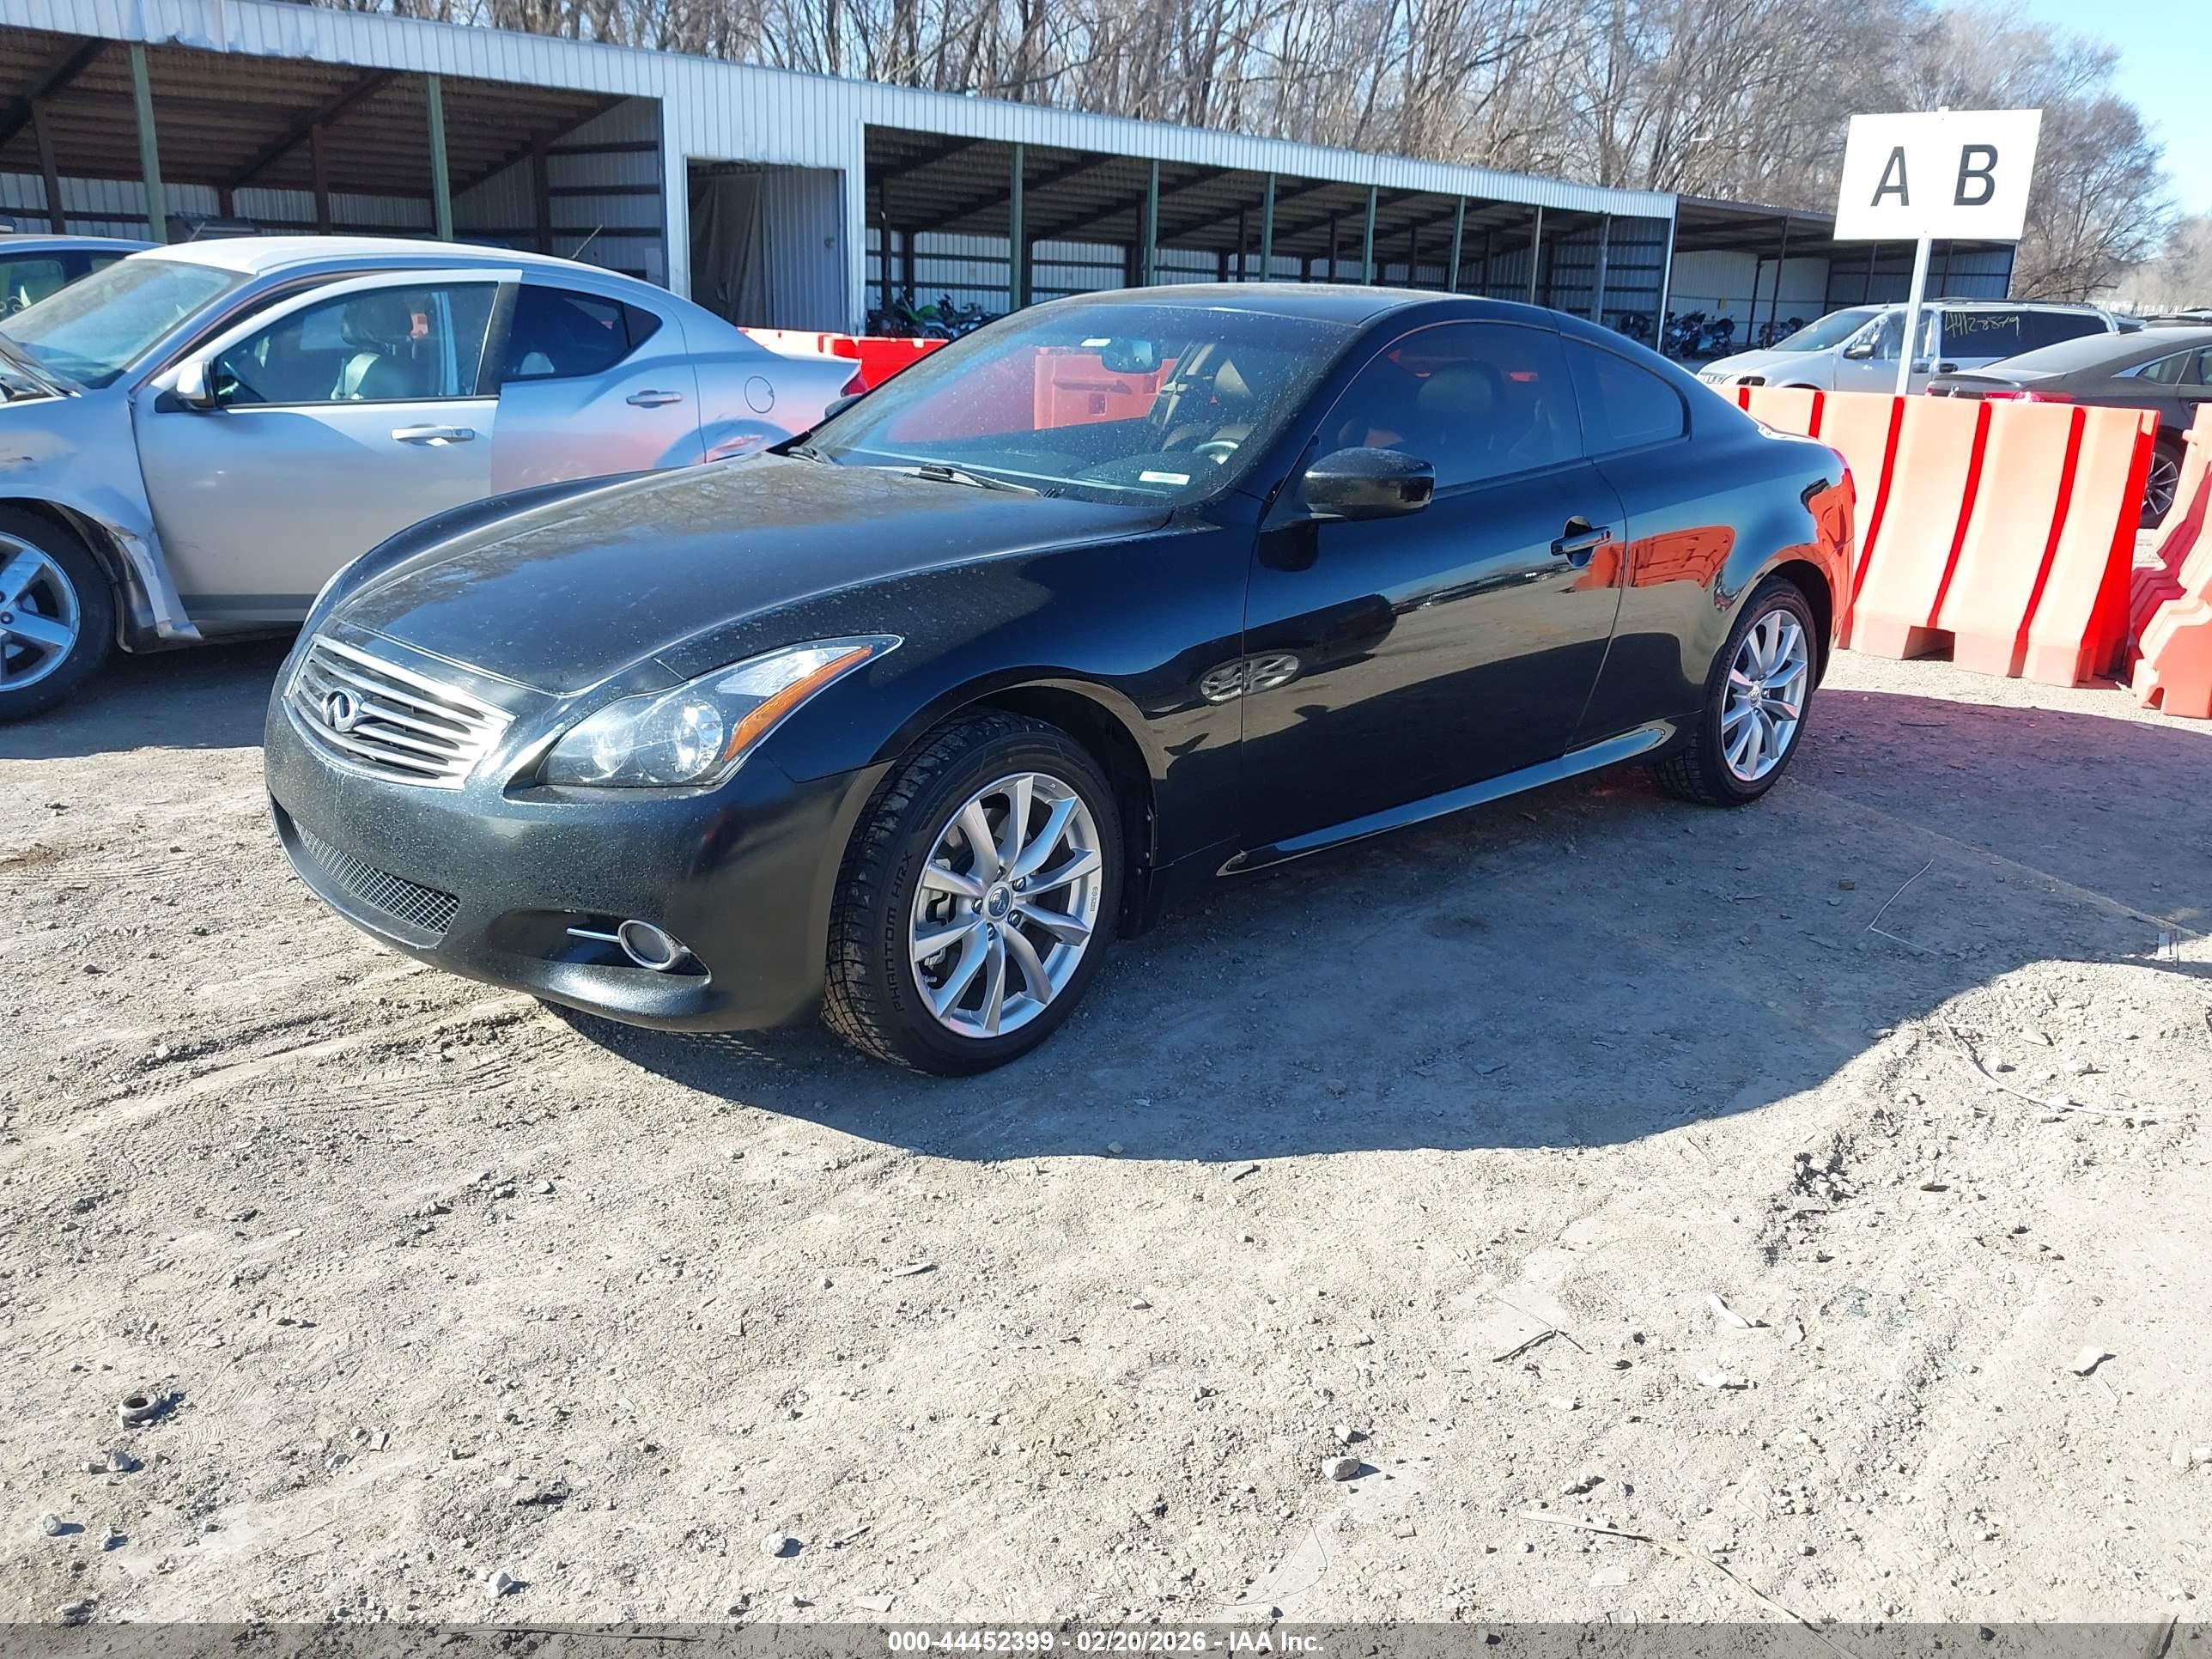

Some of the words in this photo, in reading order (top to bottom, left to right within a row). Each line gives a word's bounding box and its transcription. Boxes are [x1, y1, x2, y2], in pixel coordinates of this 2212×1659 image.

[1870, 146, 1910, 207] A
[1954, 144, 1998, 206] B
[891, 850, 913, 899] HRX
[885, 907, 904, 1012] PHANTOM
